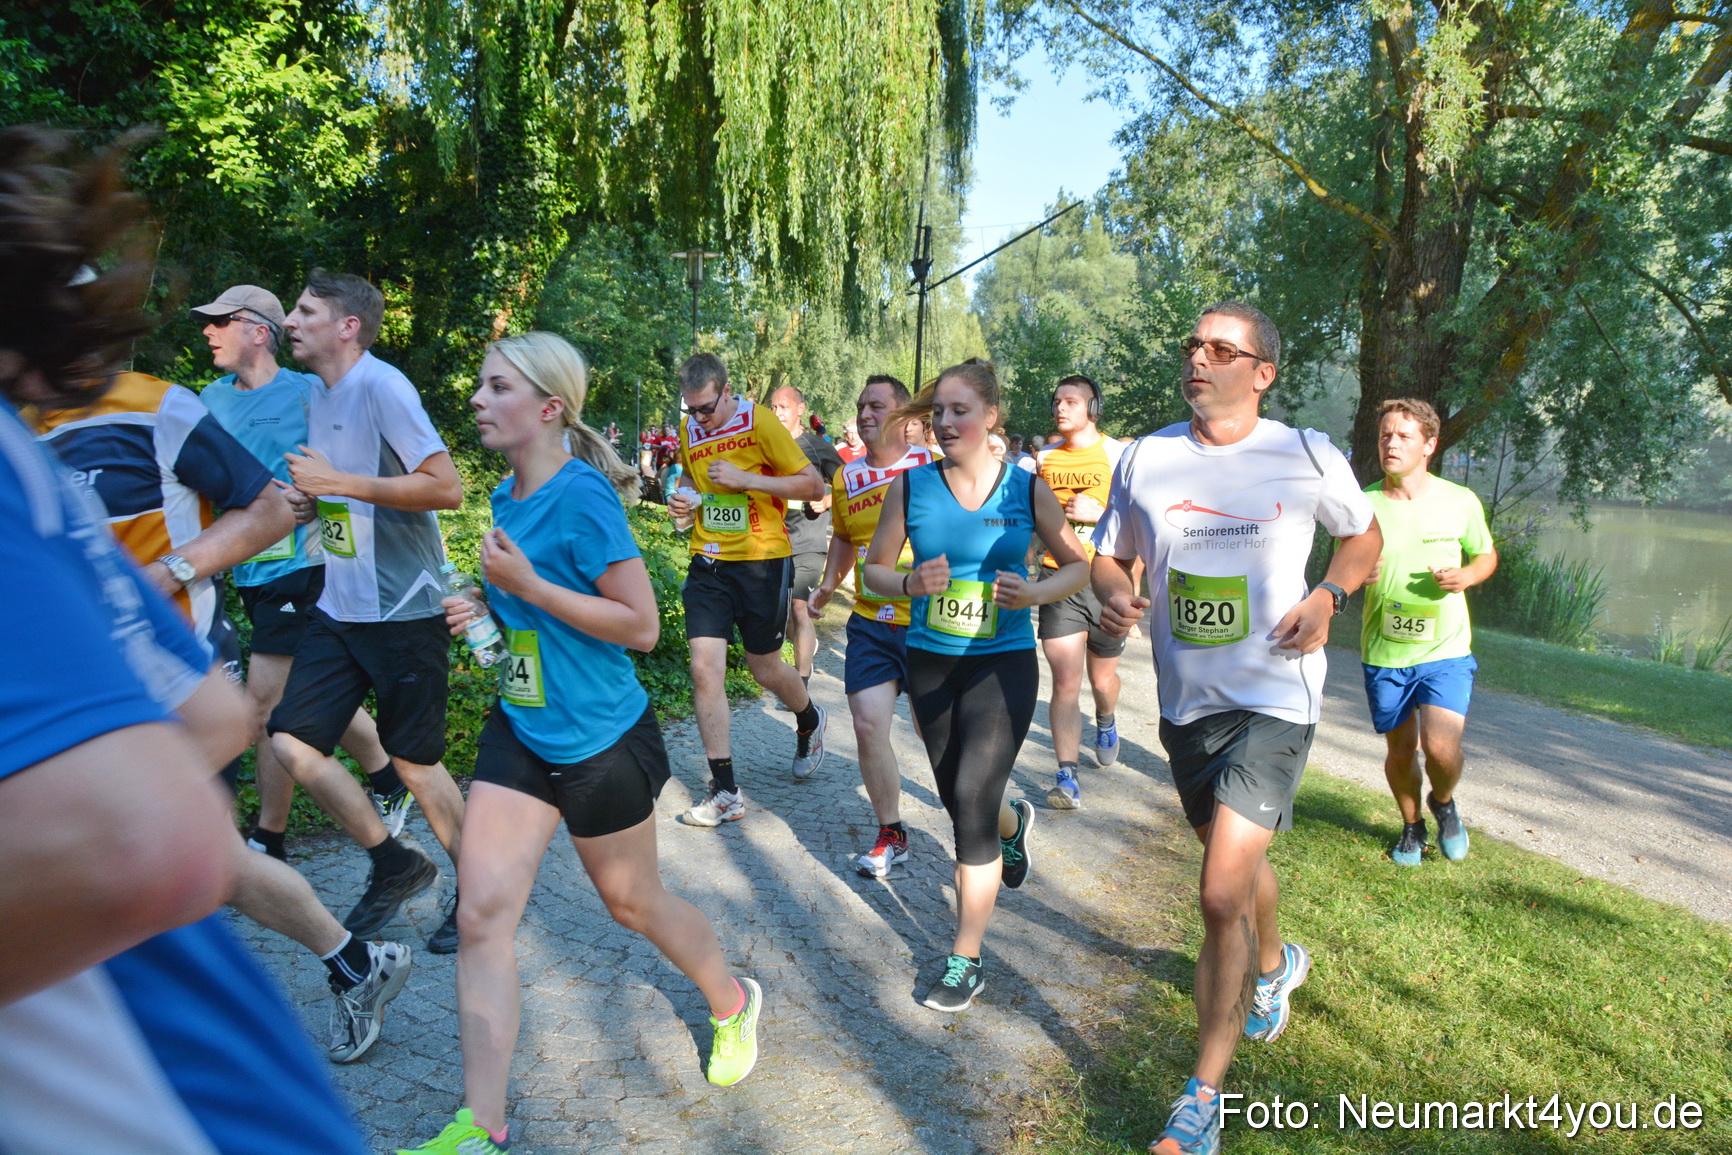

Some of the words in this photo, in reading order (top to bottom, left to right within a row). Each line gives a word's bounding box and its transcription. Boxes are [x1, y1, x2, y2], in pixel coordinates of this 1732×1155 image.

[689, 446, 713, 464] MAX
[717, 437, 757, 453] BÖGL
[1052, 472, 1102, 486] WINGS
[848, 493, 884, 516] MAX
[706, 506, 741, 522] 1280
[983, 518, 1018, 527] THULE
[1183, 524, 1260, 537] Seniorenstift
[1183, 541, 1203, 550] am
[1204, 538, 1241, 550] Tiroler
[1244, 537, 1267, 549] Hof
[936, 596, 989, 622] 1944
[1174, 596, 1235, 626] 1820
[1198, 626, 1229, 635] Stephan
[1392, 616, 1425, 632] 345
